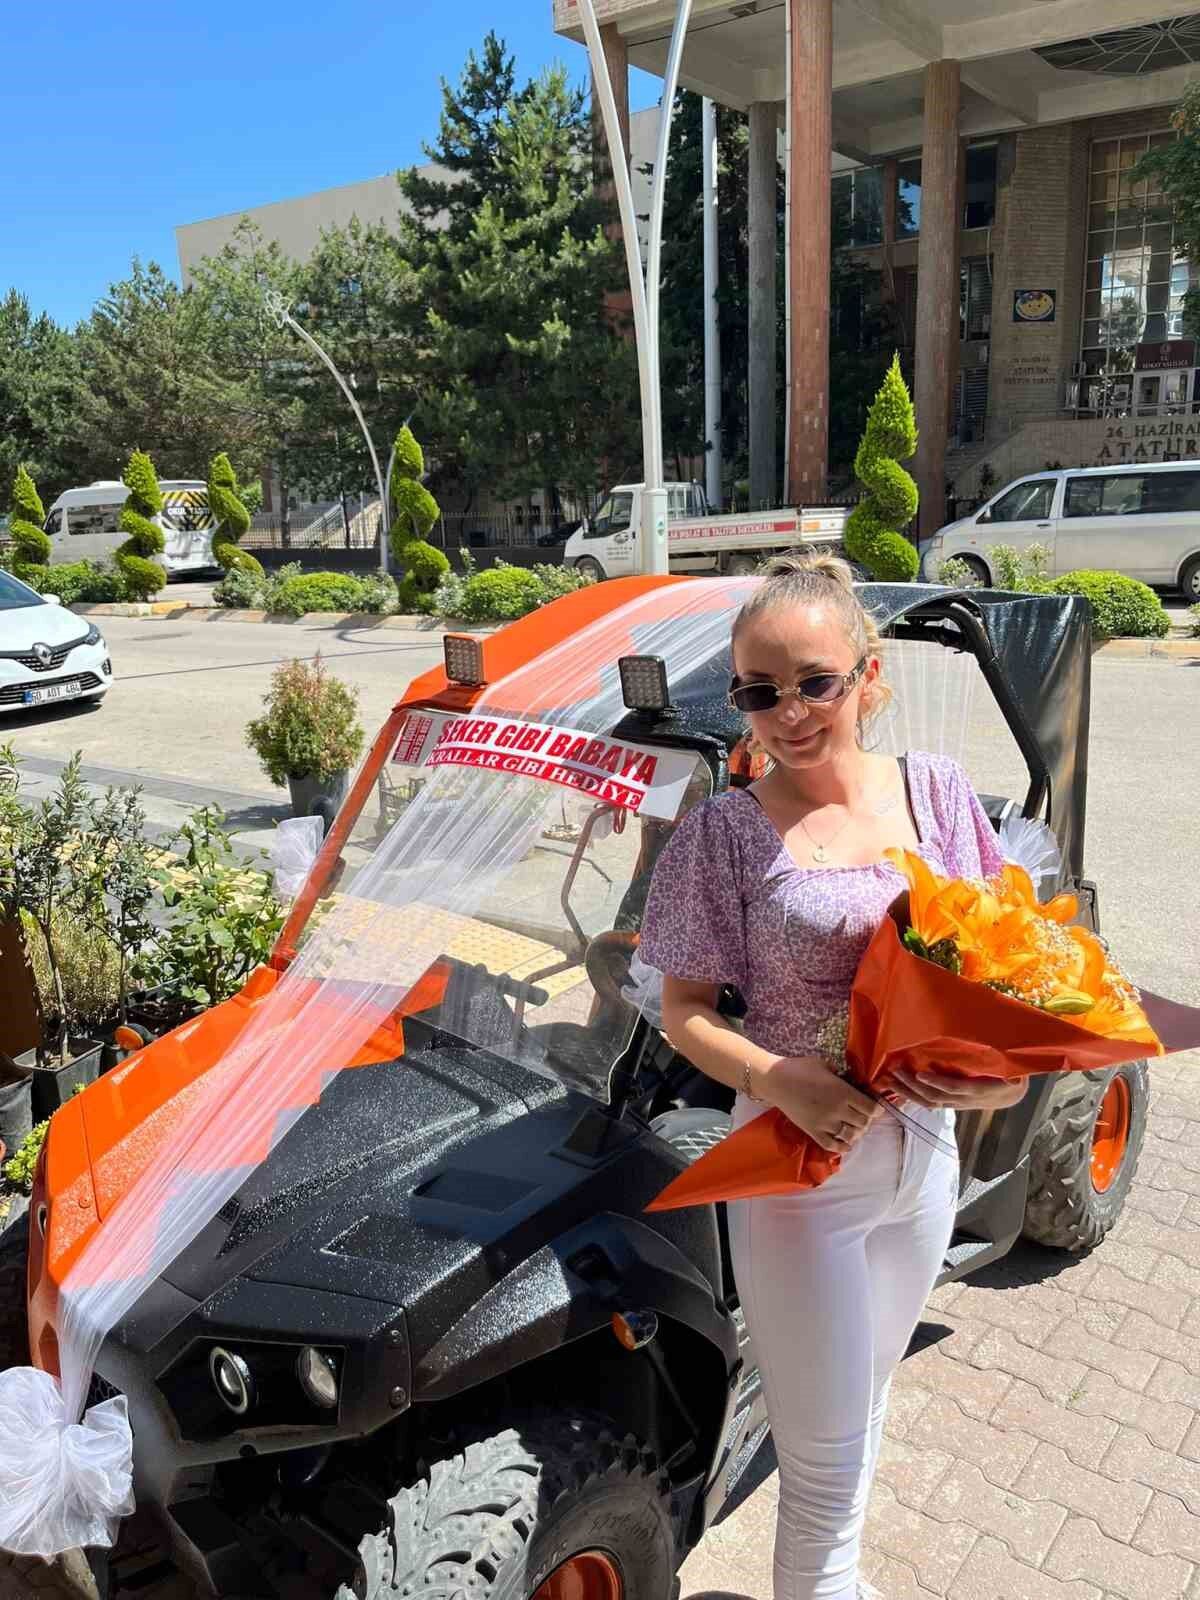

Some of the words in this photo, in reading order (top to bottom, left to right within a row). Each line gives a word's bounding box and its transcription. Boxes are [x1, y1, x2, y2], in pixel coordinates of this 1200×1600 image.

[1106, 426, 1123, 438] 26
[427, 748, 500, 769] KRALLAR
[502, 757, 549, 779] GİBİ
[549, 764, 642, 810] HEDİYE
[495, 723, 554, 753] GİBİ
[546, 733, 658, 787] BABAYA
